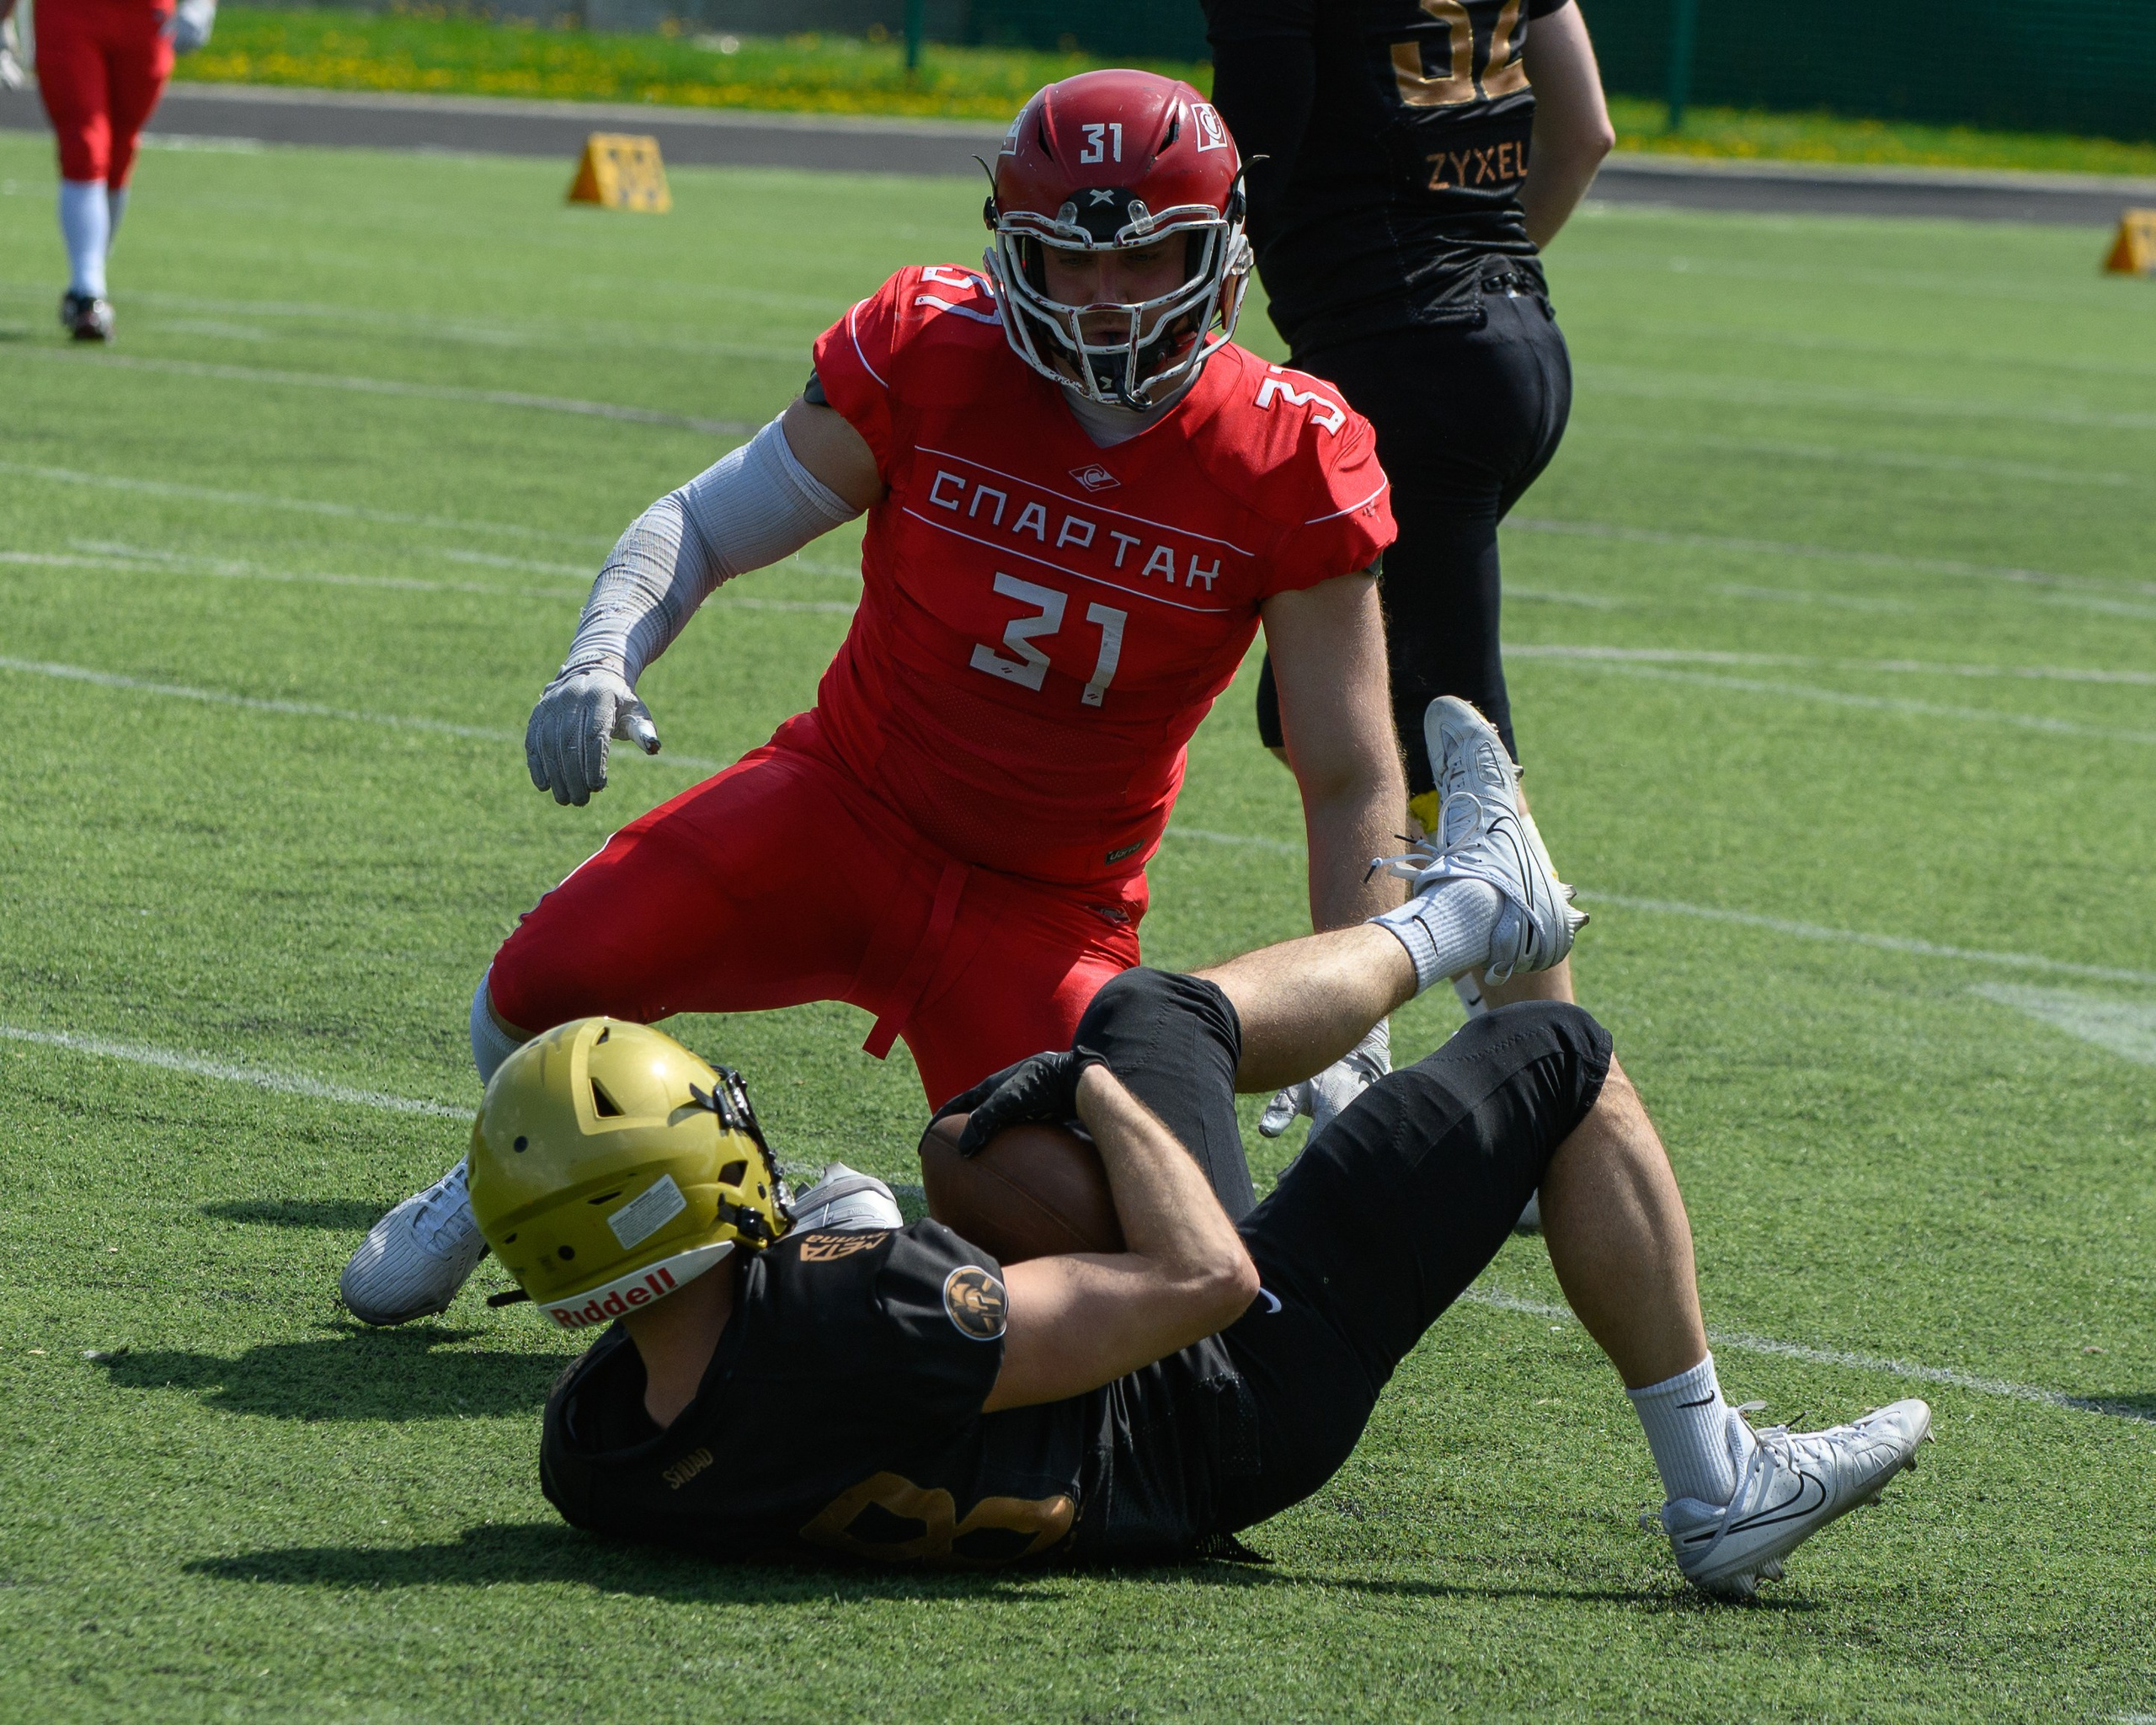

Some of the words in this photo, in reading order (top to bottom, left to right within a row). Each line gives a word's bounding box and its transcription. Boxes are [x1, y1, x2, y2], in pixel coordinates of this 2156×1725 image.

[1081, 122, 1122, 164] 31
[1426, 140, 1529, 190] ZYXEL
[929, 470, 1220, 590] СПАРТАК
[969, 572, 1128, 708] 31
[549, 1267, 678, 1328] Riddell
